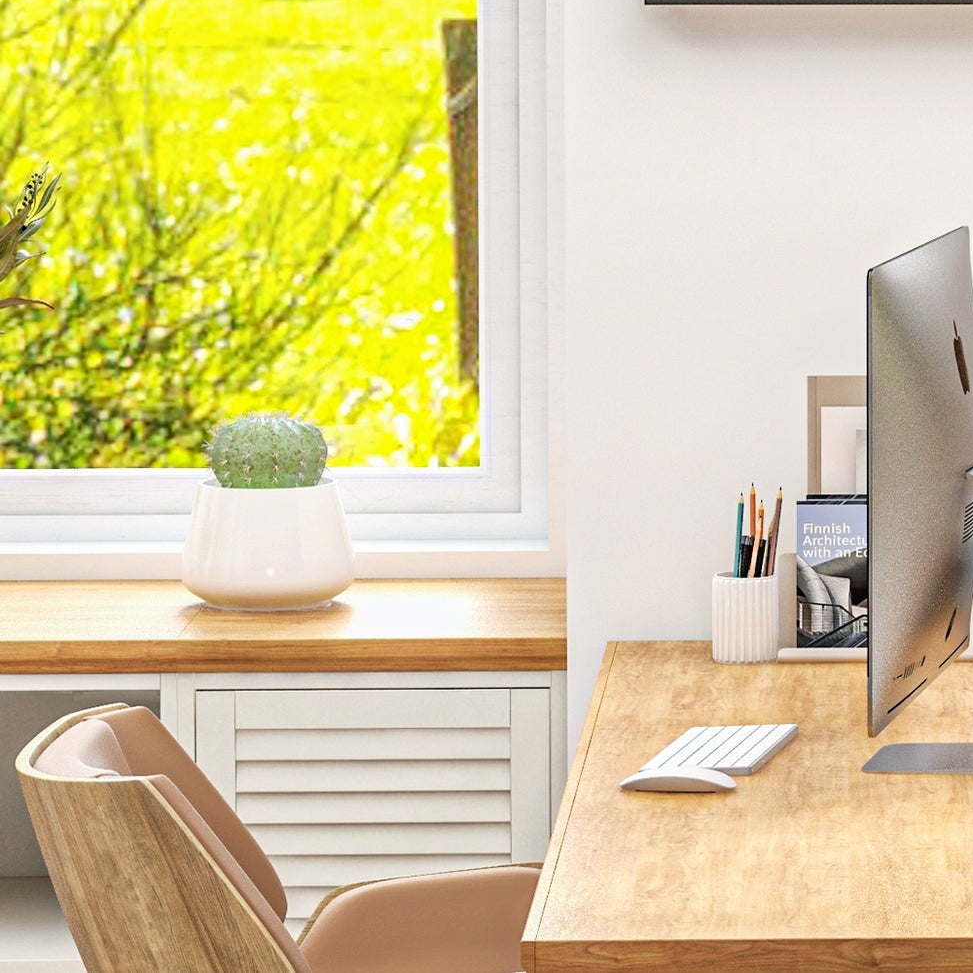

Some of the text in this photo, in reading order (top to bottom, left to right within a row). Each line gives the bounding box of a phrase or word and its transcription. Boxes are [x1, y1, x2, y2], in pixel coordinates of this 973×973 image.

[803, 523, 851, 534] Finnish
[803, 547, 831, 558] with
[835, 549, 851, 558] an
